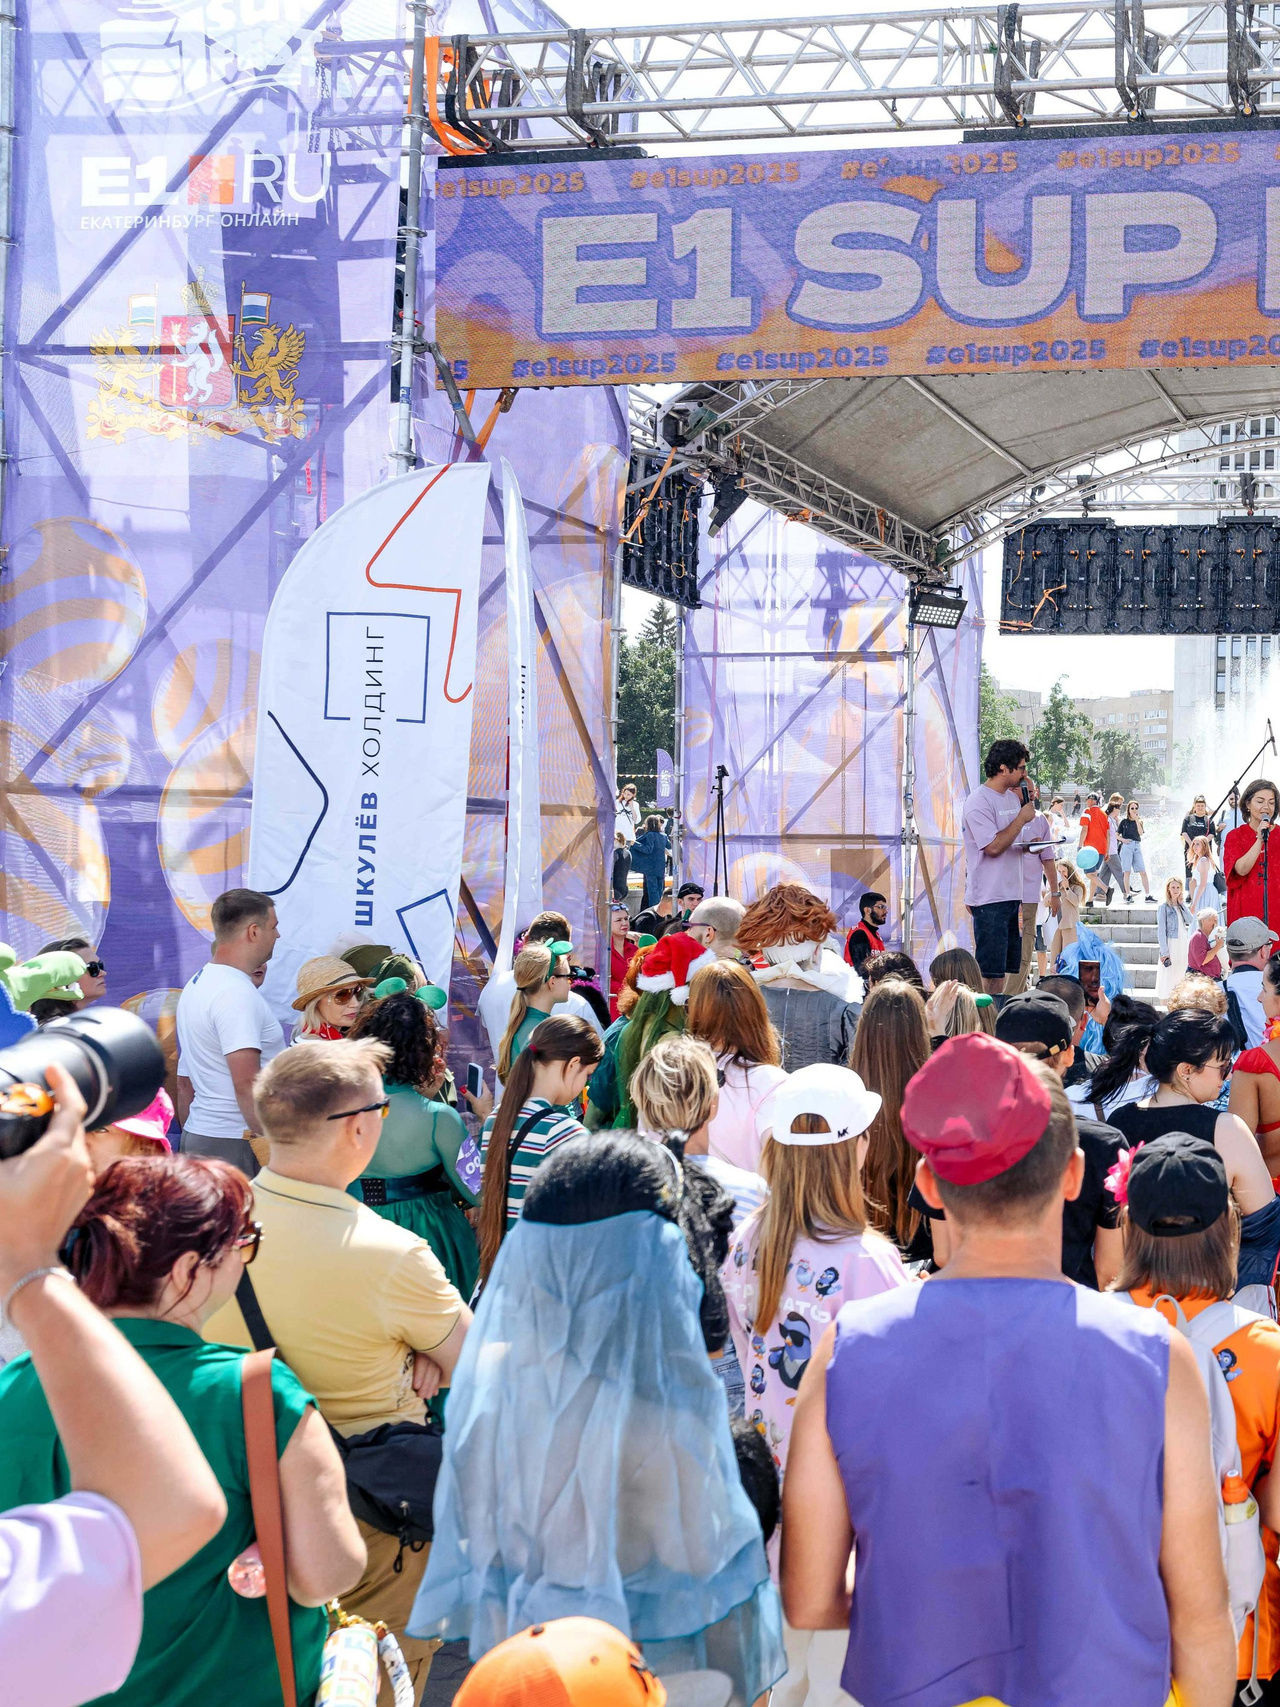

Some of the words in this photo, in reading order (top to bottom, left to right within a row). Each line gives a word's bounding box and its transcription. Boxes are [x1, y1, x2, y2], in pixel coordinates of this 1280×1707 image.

[242, 152, 332, 204] RU
[629, 162, 799, 190] #e1sup2025
[841, 151, 1018, 180] #e2025
[1057, 142, 1241, 171] #e1sup2025
[80, 214, 215, 230] ЕКАТЕРИНБУРГ
[220, 209, 300, 228] ОНЛАЙН
[542, 207, 751, 334] E1
[791, 191, 1218, 325] SUP
[512, 351, 677, 380] #e1sup2025
[716, 345, 889, 374] #e1sup2025
[926, 339, 1106, 367] #e1sup2025
[362, 626, 386, 777] ХОЛДИНГ
[354, 791, 378, 926] ШКУЛЁВ
